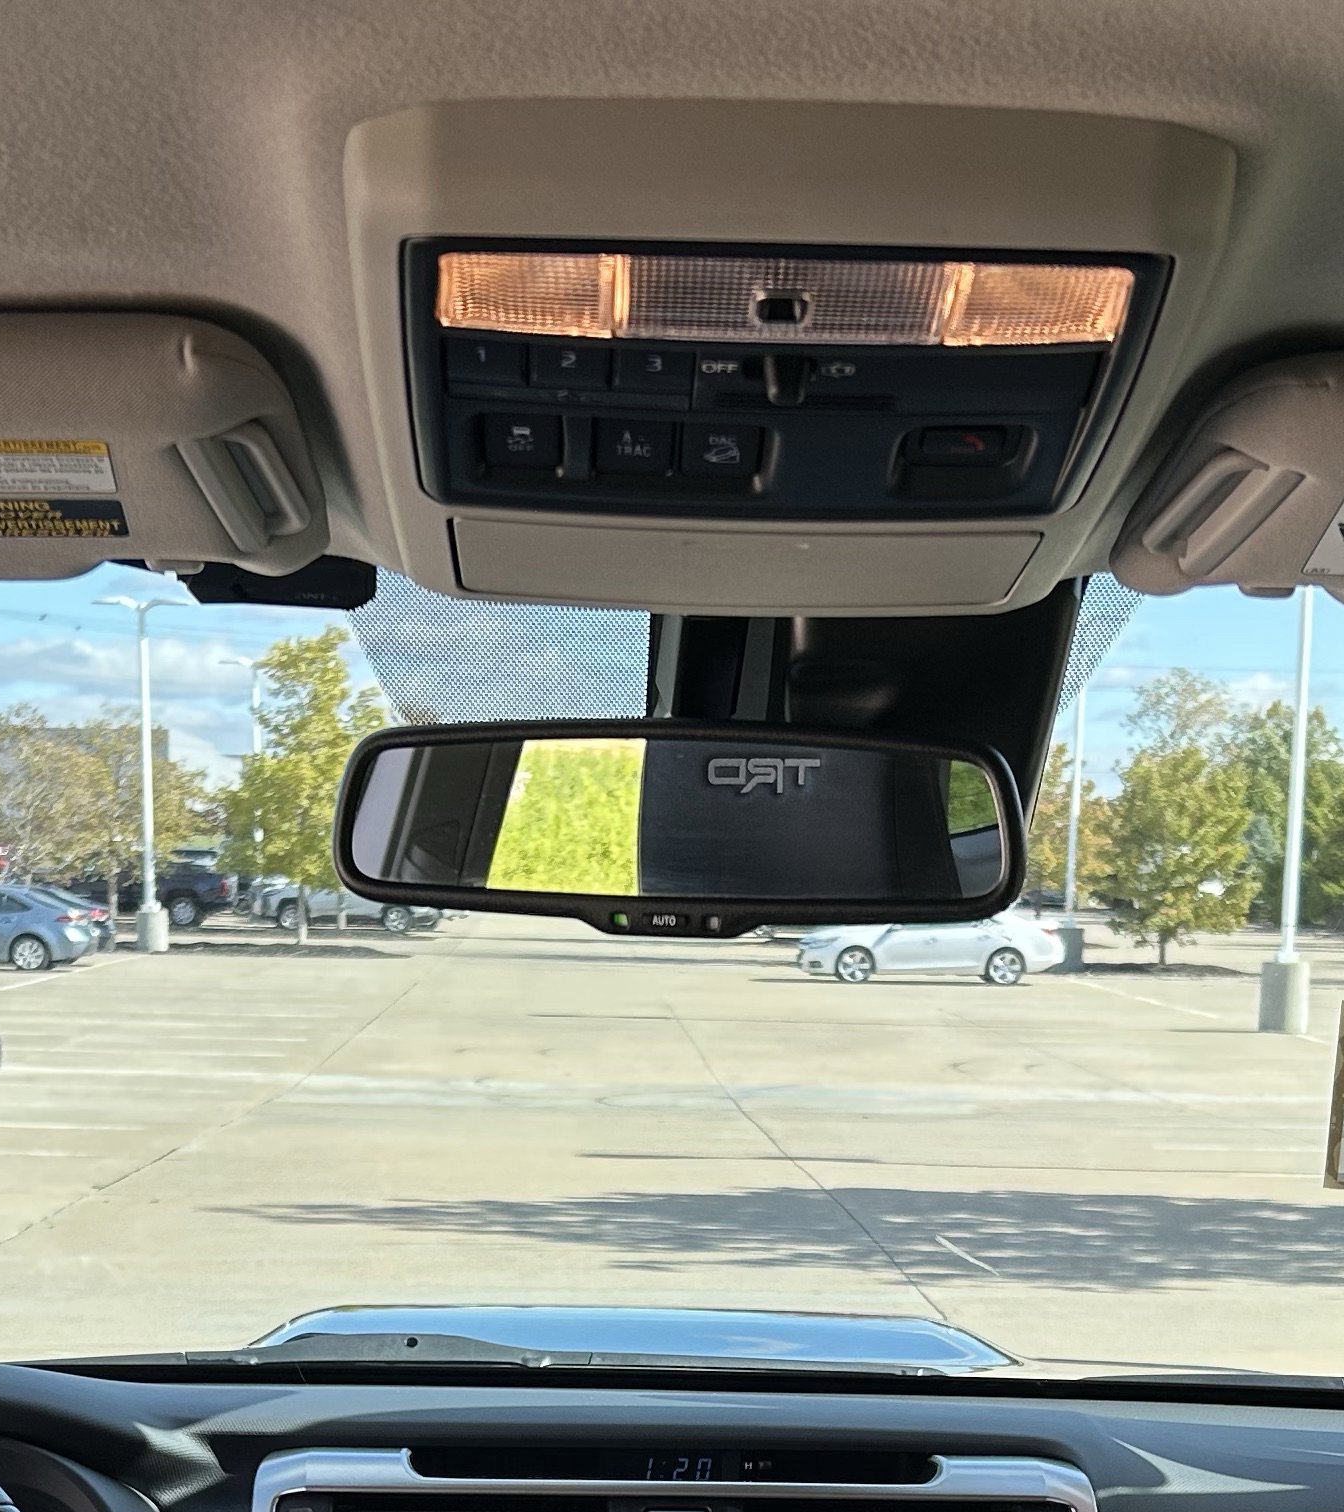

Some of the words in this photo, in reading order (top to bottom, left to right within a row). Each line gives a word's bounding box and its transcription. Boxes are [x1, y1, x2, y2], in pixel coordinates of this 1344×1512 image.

[475, 349, 486, 363] 1
[560, 352, 576, 368] 2
[646, 355, 661, 372] 3
[701, 360, 738, 374] OFF
[616, 444, 651, 458] TRAC
[652, 915, 677, 927] AUTO
[646, 1458, 712, 1481] 1:20
